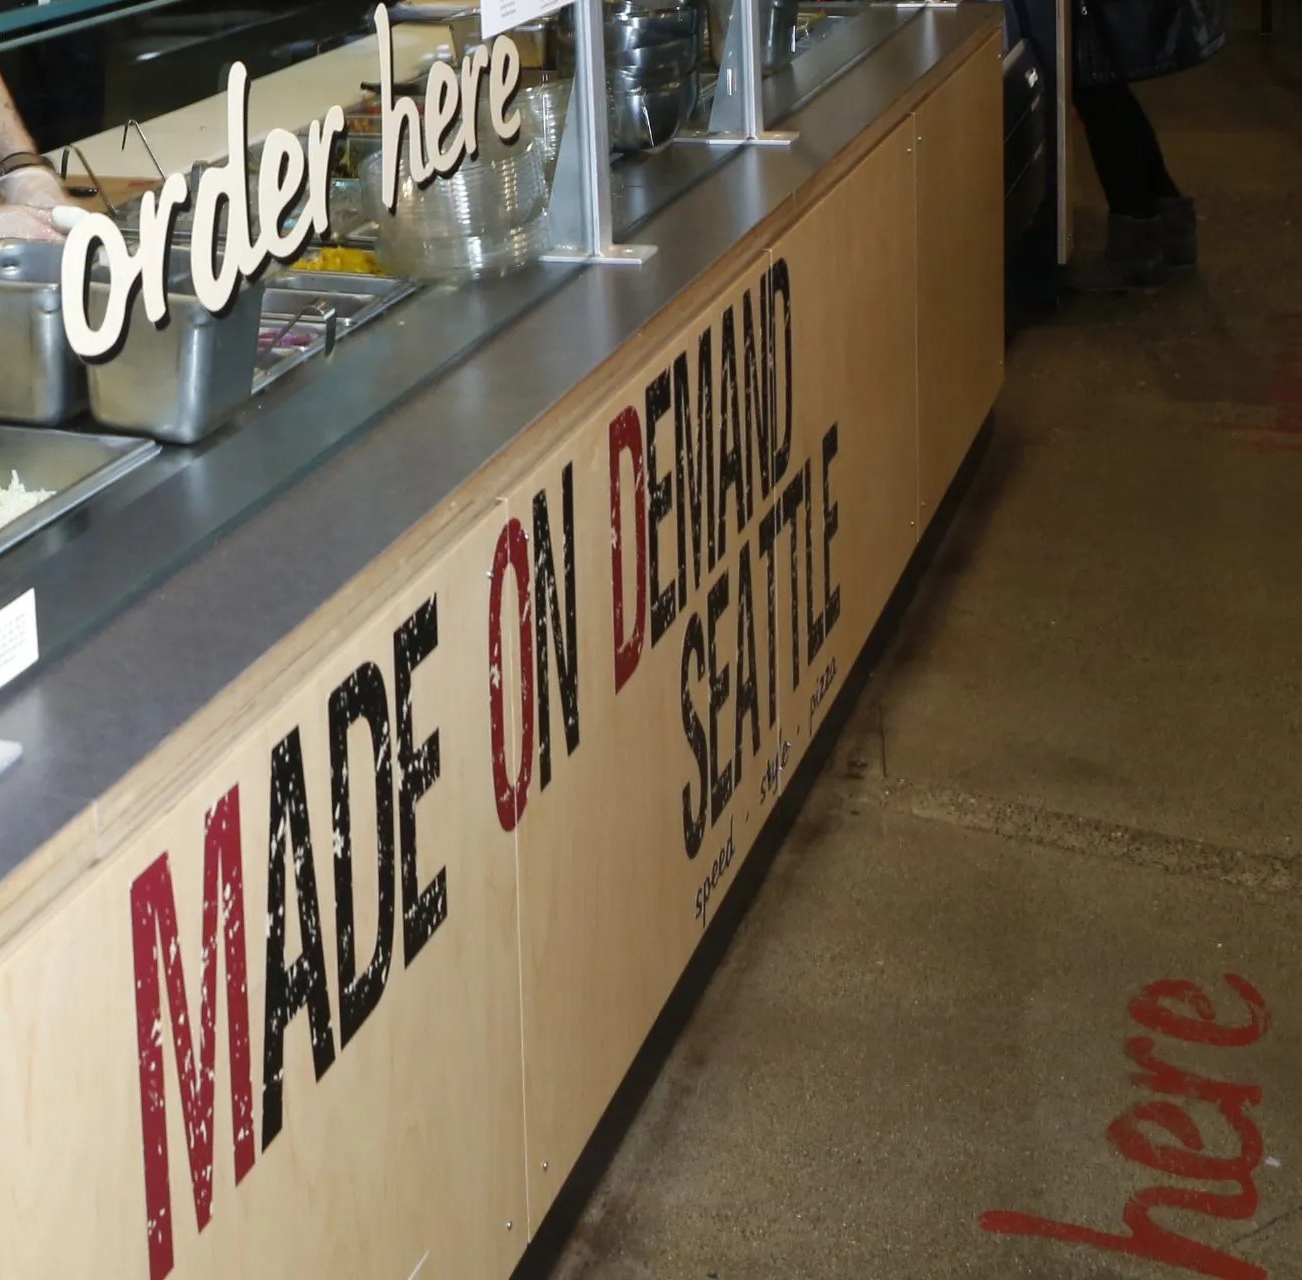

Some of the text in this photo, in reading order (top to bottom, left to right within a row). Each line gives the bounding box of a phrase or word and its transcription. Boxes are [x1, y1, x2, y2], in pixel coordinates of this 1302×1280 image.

[60, 1, 522, 359] order here
[488, 256, 792, 833] ON DEMAND
[681, 420, 841, 860] SEATTLE
[130, 591, 449, 1280] MADE
[695, 812, 736, 928] speed
[978, 972, 1273, 1280] here
